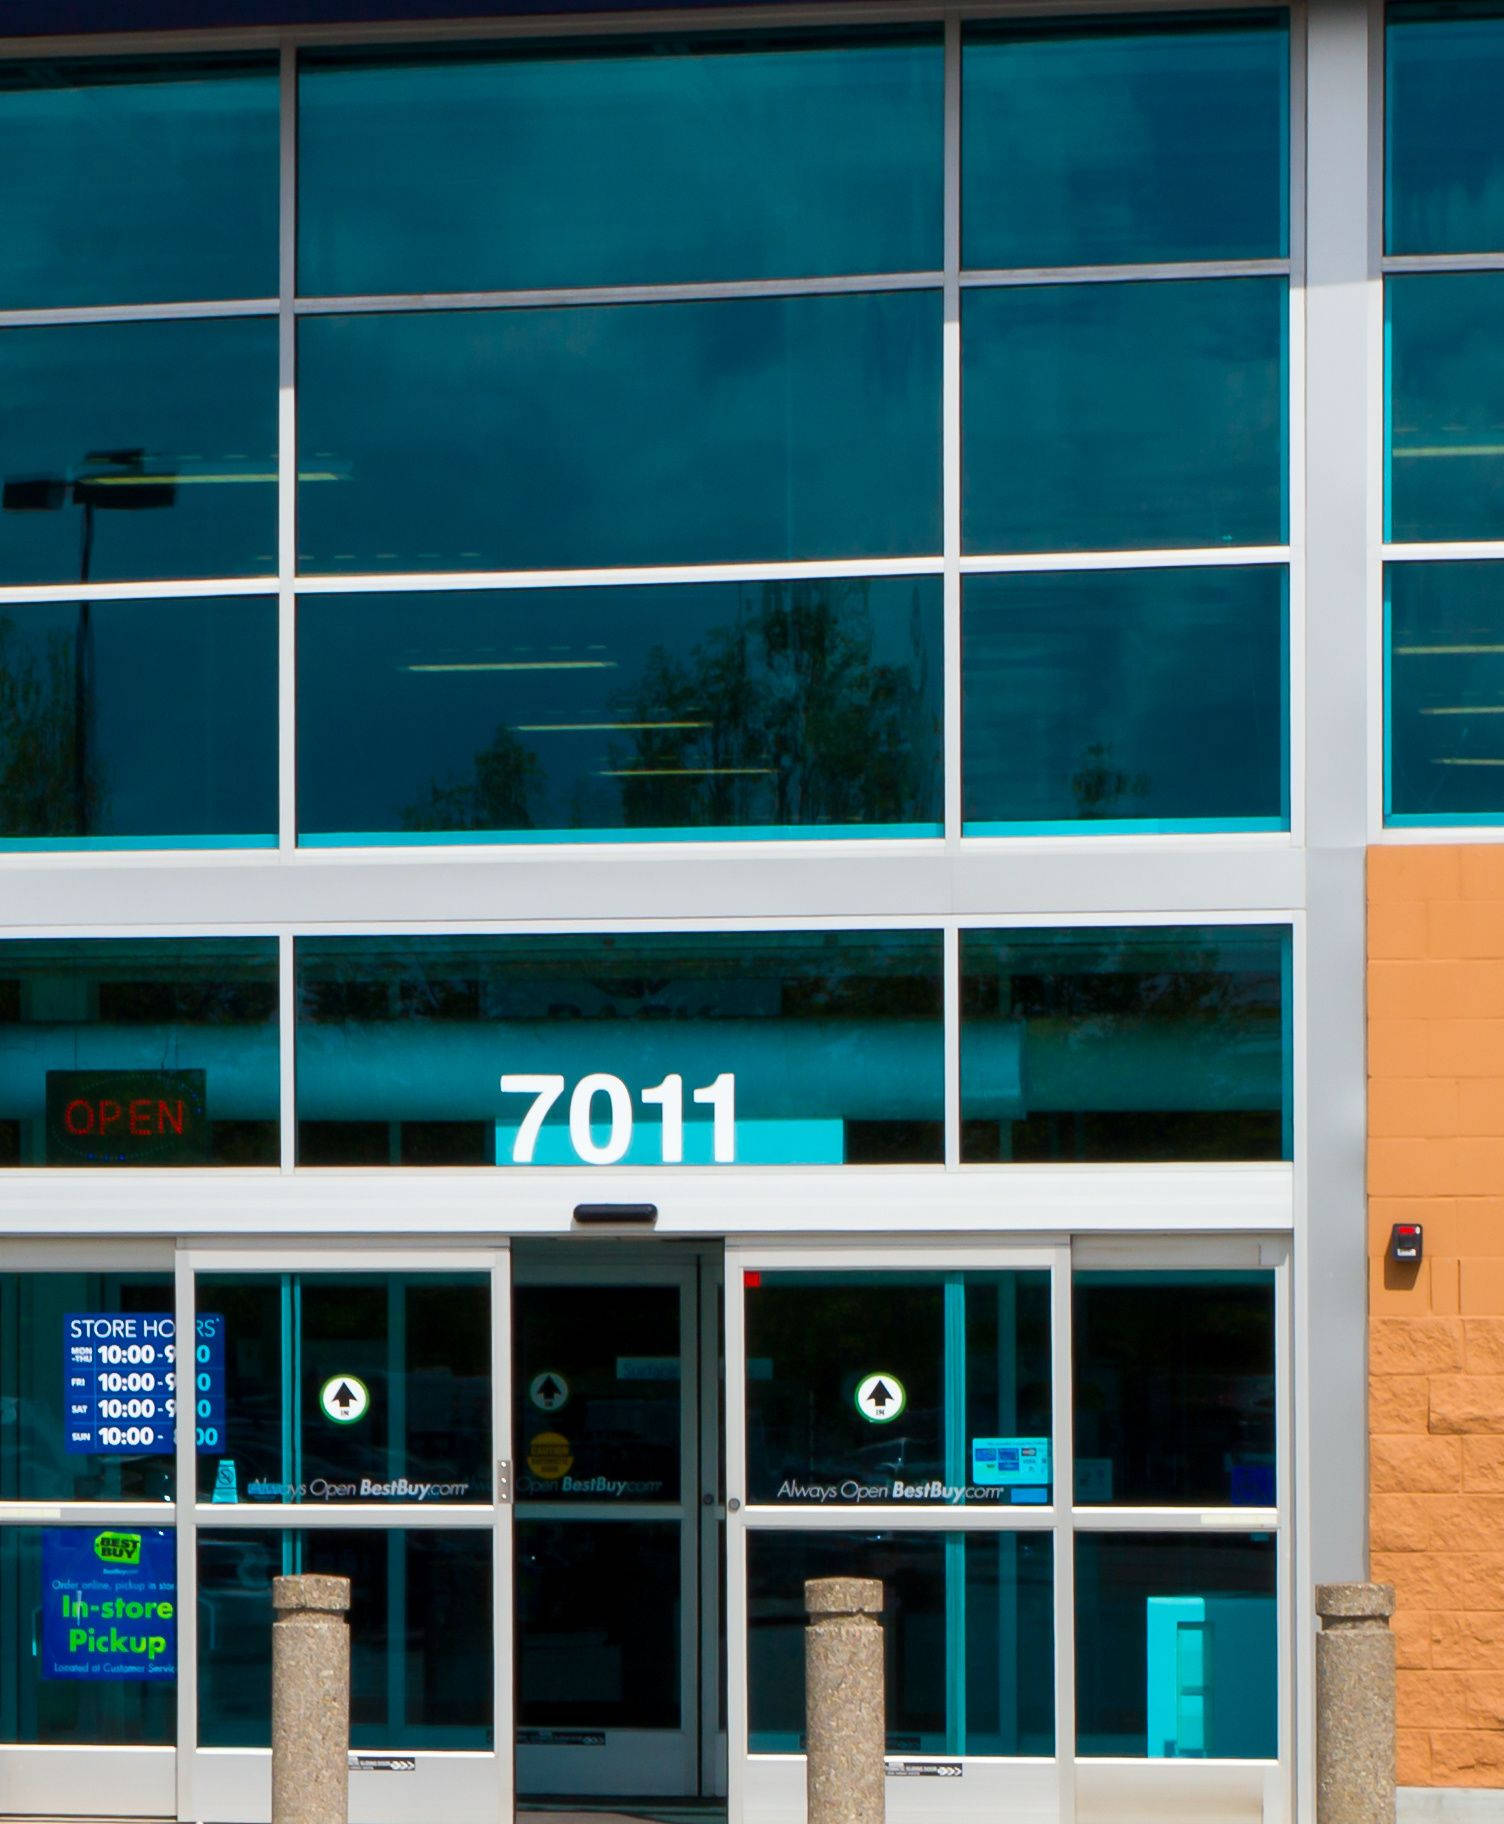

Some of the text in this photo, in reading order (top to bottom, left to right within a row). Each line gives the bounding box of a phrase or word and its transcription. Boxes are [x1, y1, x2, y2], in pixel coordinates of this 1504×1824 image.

[64, 1099, 184, 1136] OPEN
[500, 1073, 735, 1165] 7011
[71, 1319, 137, 1338] STORE
[310, 1479, 357, 1501] Open
[360, 1479, 469, 1501] BestBuy.com
[562, 1476, 662, 1495] BestBuy.com
[777, 1480, 1004, 1504] Always Open BestBuy.com
[100, 1536, 140, 1549] BEST
[100, 1547, 137, 1559] BUY
[62, 1595, 174, 1619] In-store
[69, 1627, 167, 1660] Pickup
[54, 1663, 90, 1673] Located
[103, 1663, 145, 1673] Customer
